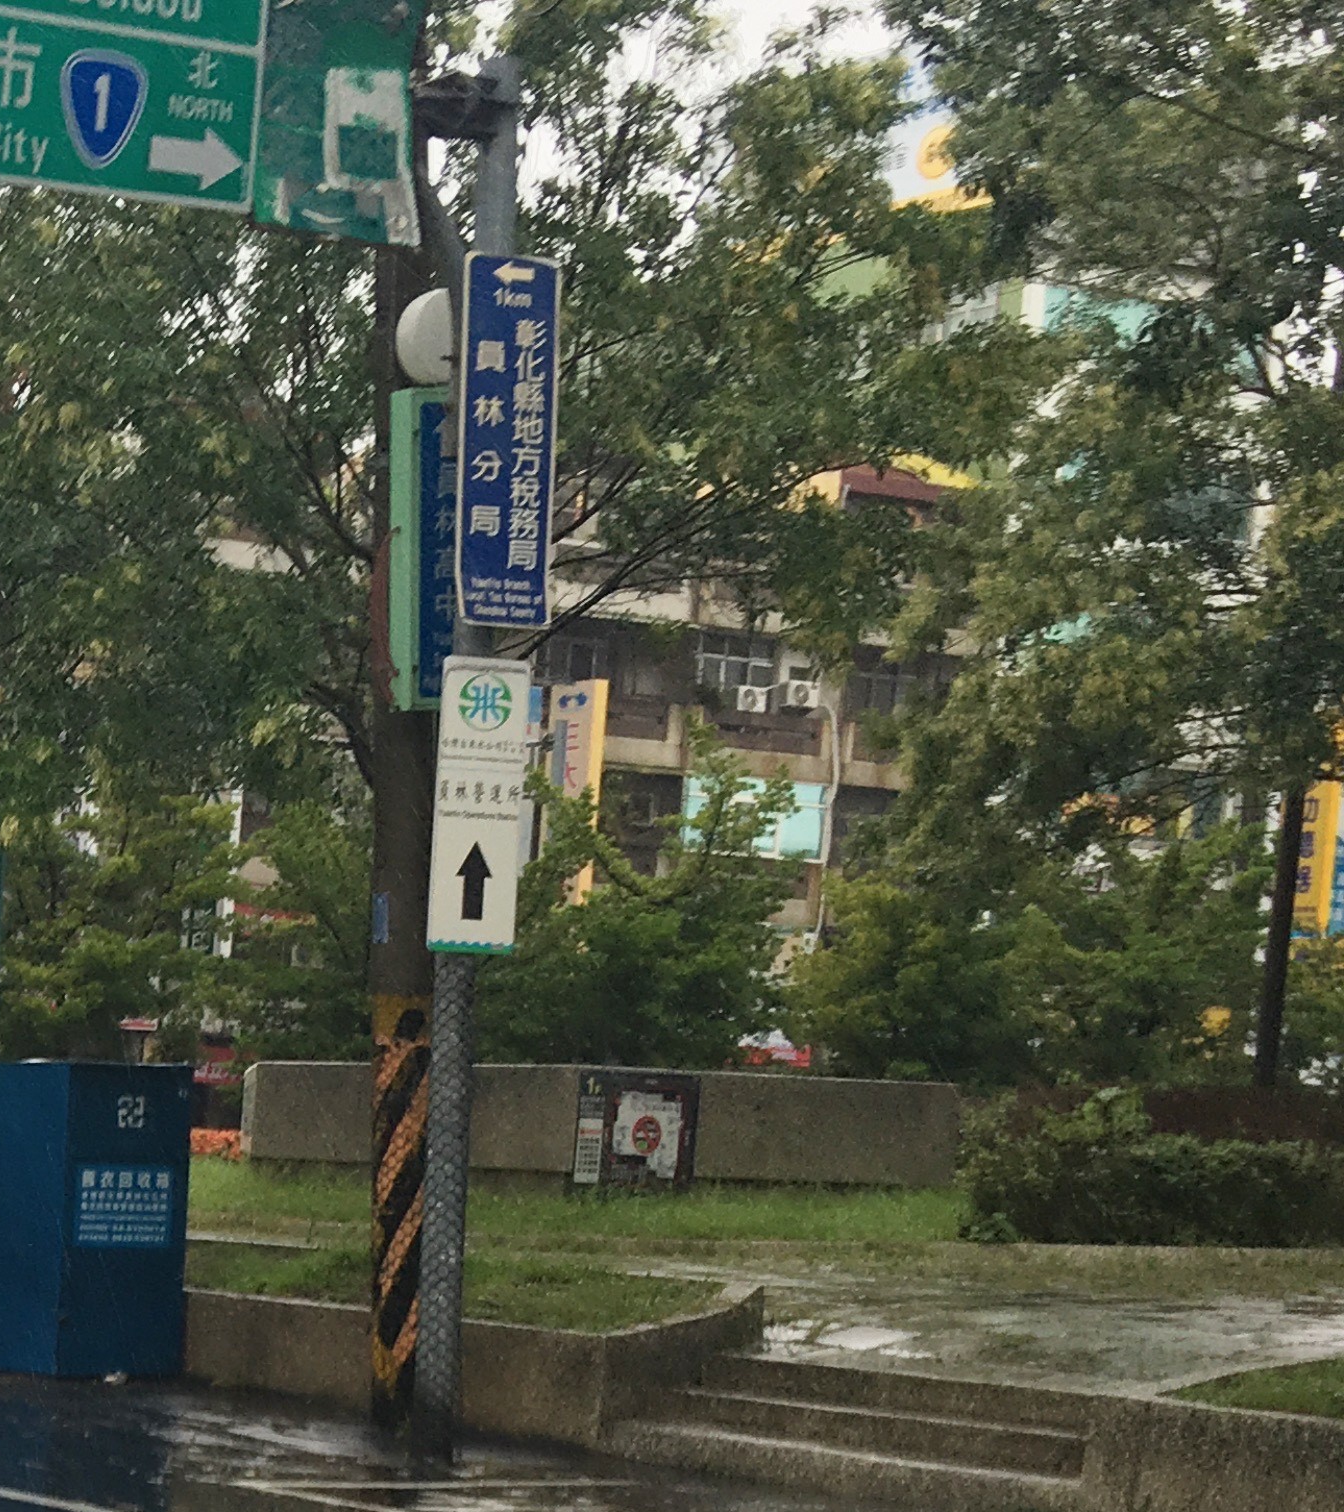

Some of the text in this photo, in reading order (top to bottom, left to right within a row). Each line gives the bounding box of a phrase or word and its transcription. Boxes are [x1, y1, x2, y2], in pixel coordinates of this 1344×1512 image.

[188, 50, 220, 89] 北
[94, 72, 111, 132] 1
[168, 93, 235, 122] NORTH
[492, 286, 533, 308] 1km
[469, 339, 507, 538] 員林分局
[507, 317, 548, 572] 彰化縣地方稅務局
